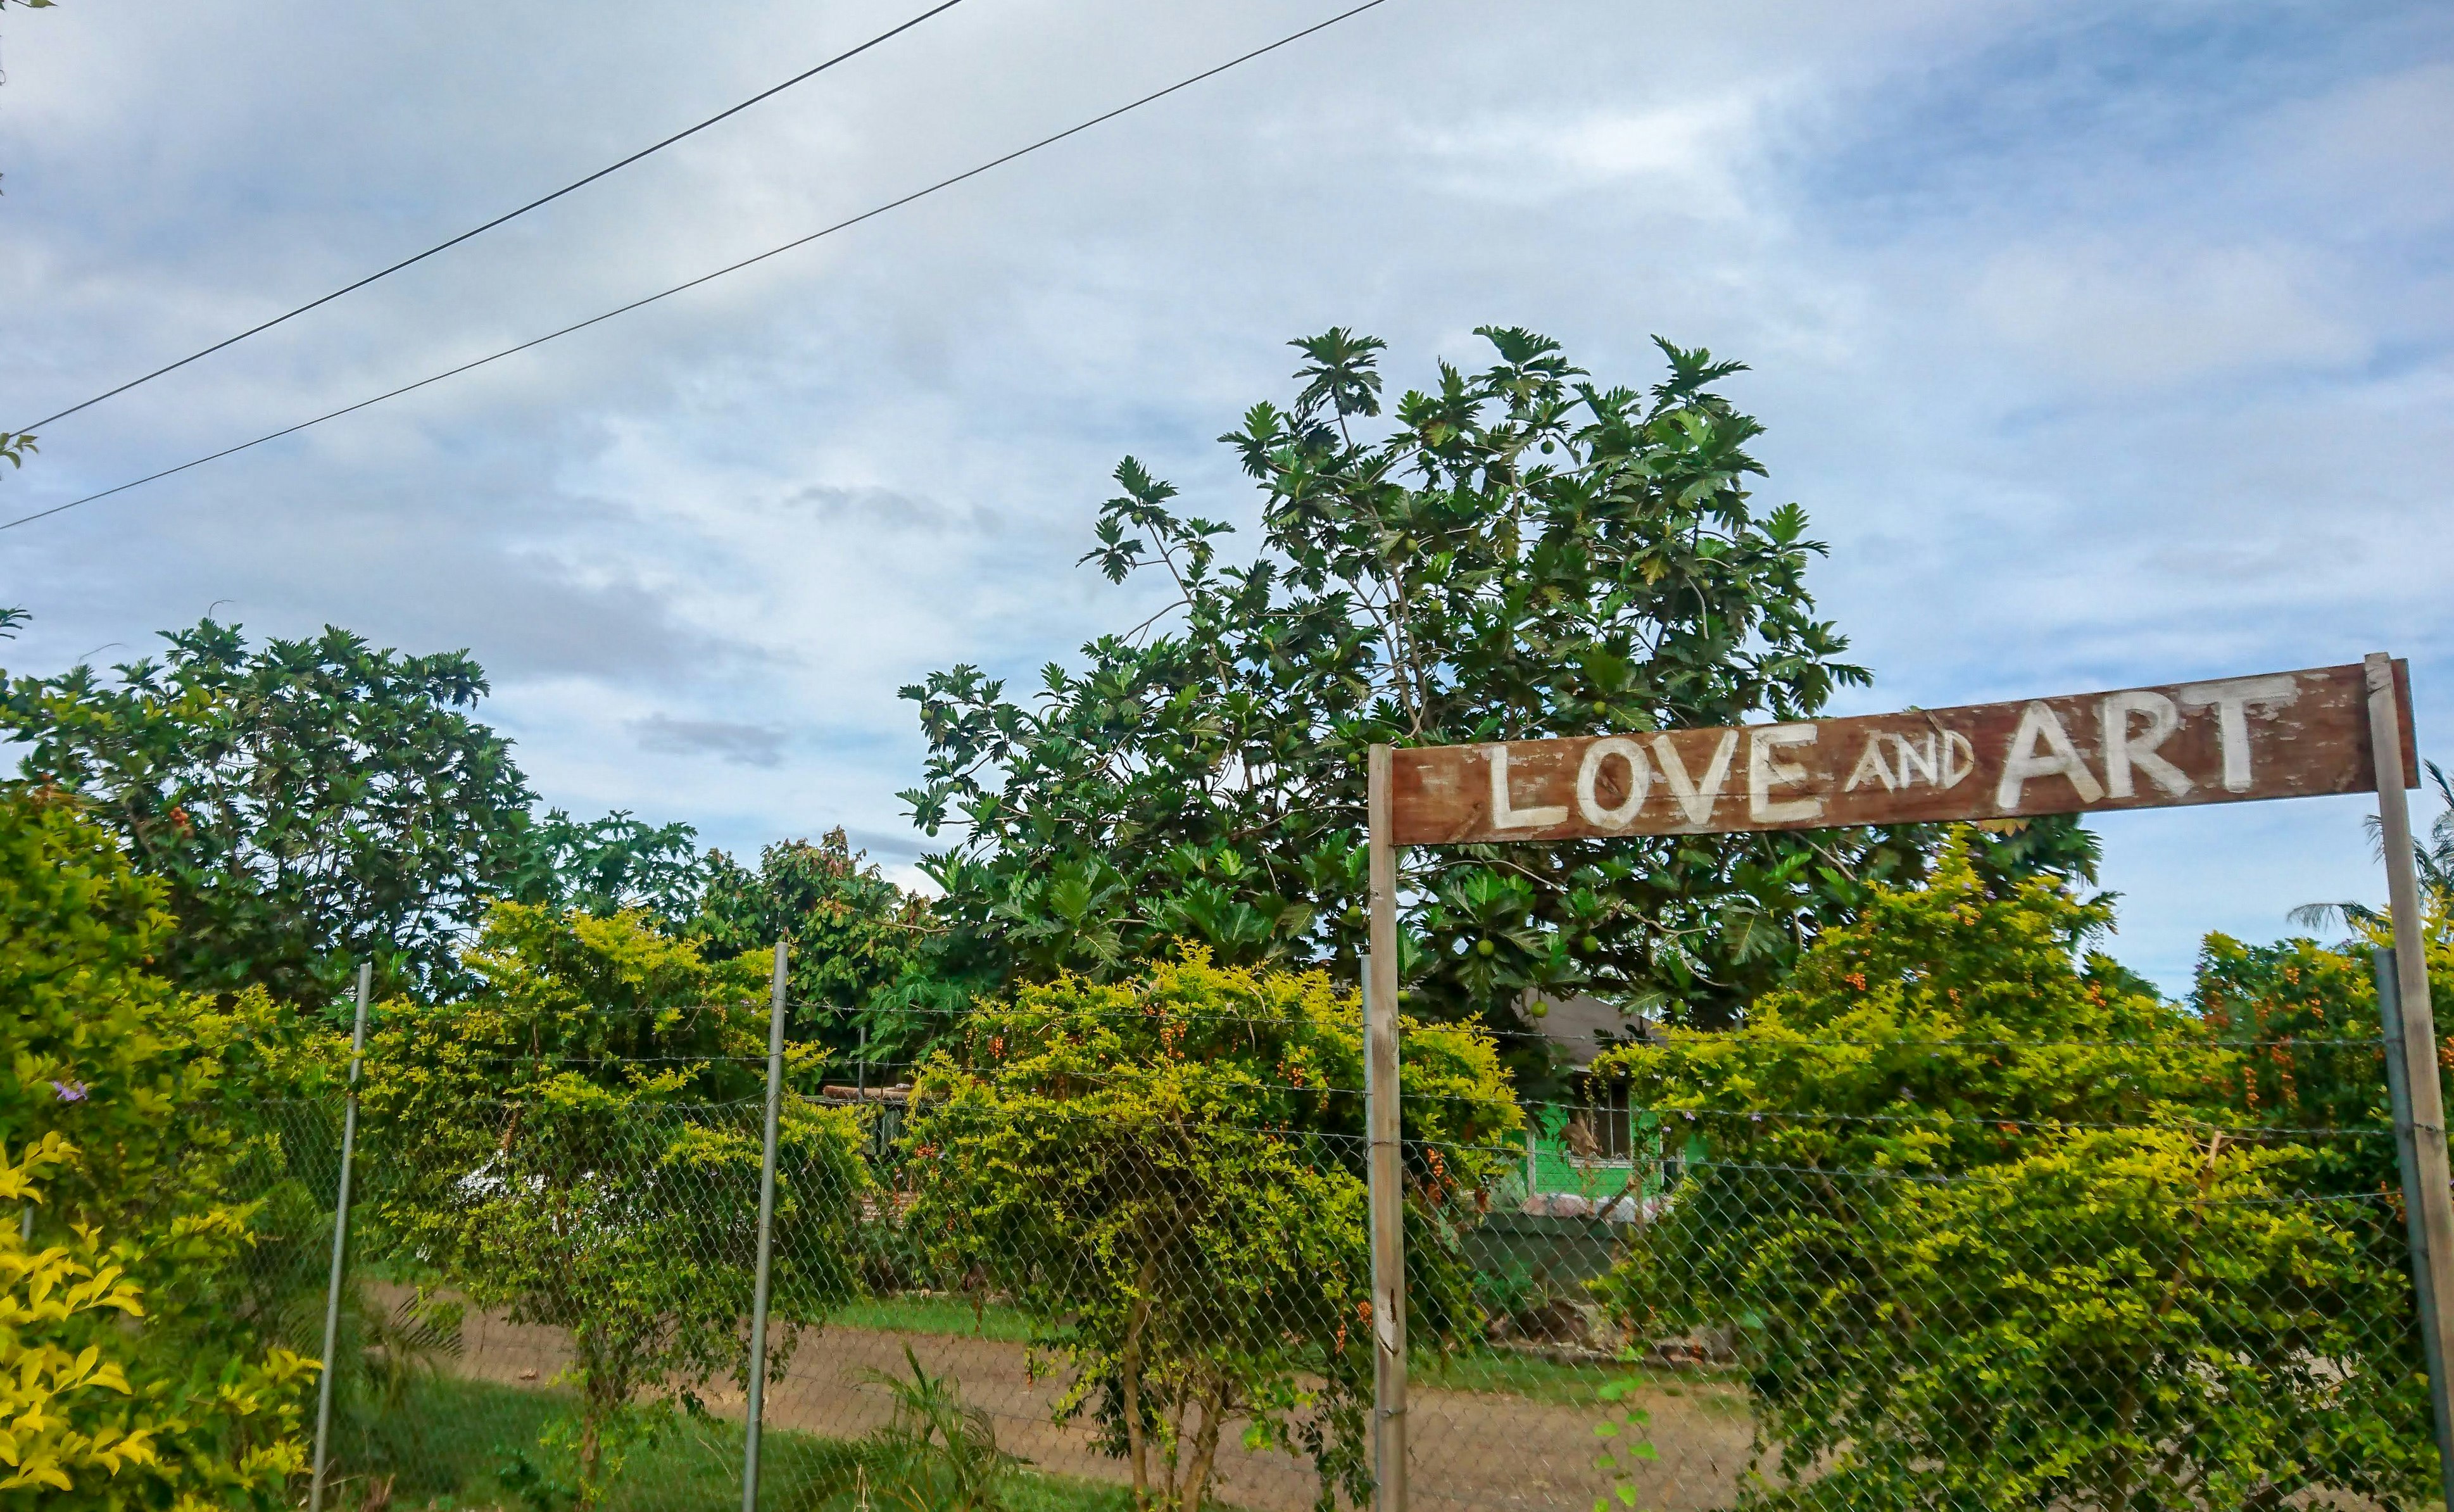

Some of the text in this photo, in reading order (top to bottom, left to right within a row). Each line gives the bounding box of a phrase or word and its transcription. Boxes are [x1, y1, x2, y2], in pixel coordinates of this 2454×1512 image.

[1488, 675, 2298, 830] LOVE AND ART
